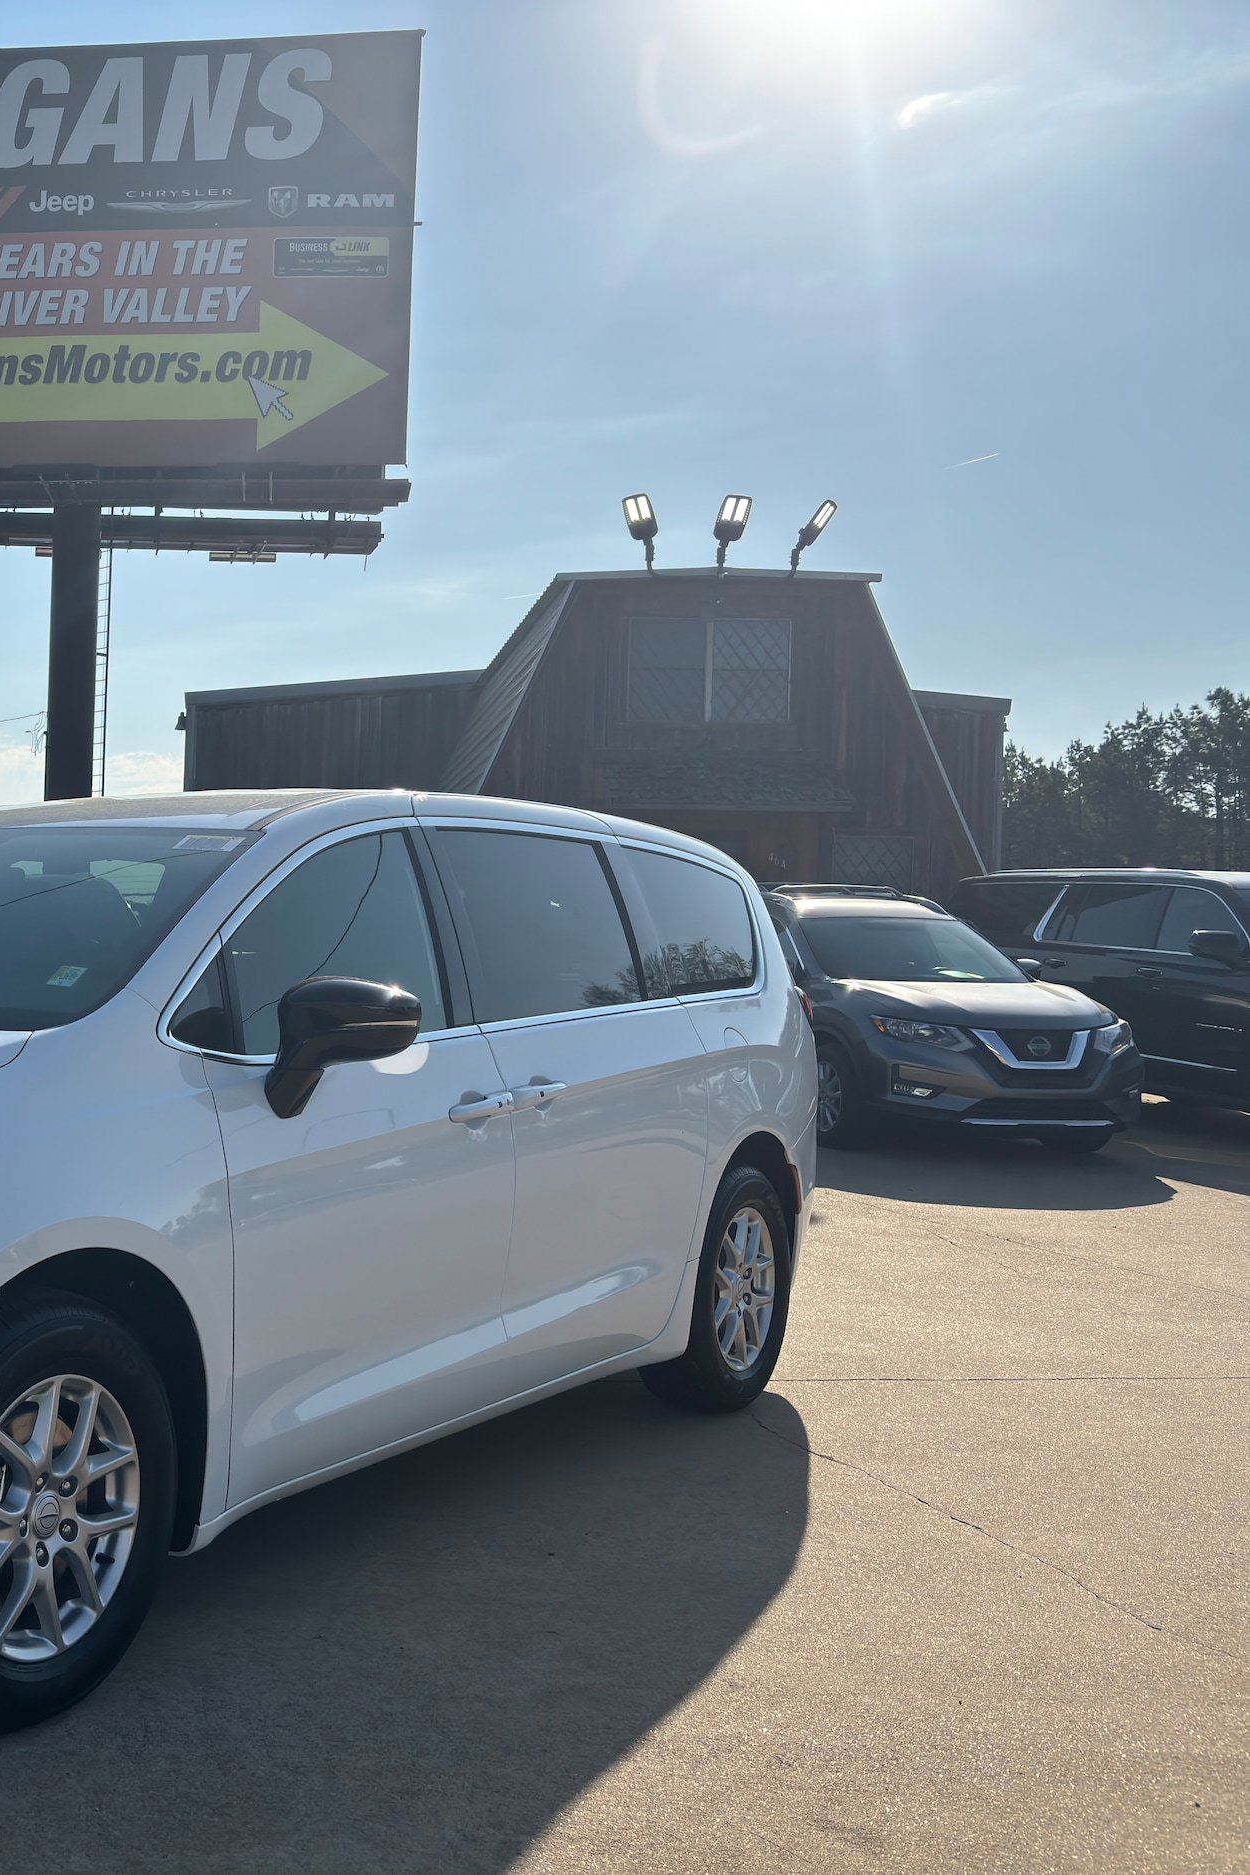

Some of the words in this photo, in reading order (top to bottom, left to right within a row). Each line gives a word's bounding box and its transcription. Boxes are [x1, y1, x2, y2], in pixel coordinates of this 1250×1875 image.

[29, 189, 95, 216] Jeep
[125, 187, 233, 198] CHRYSLER
[307, 193, 396, 208] RAM
[114, 240, 160, 277] IN
[172, 238, 249, 275] THE
[289, 242, 328, 252] BUSINESS
[347, 242, 371, 252] LINK
[102, 285, 252, 325] VALLEY
